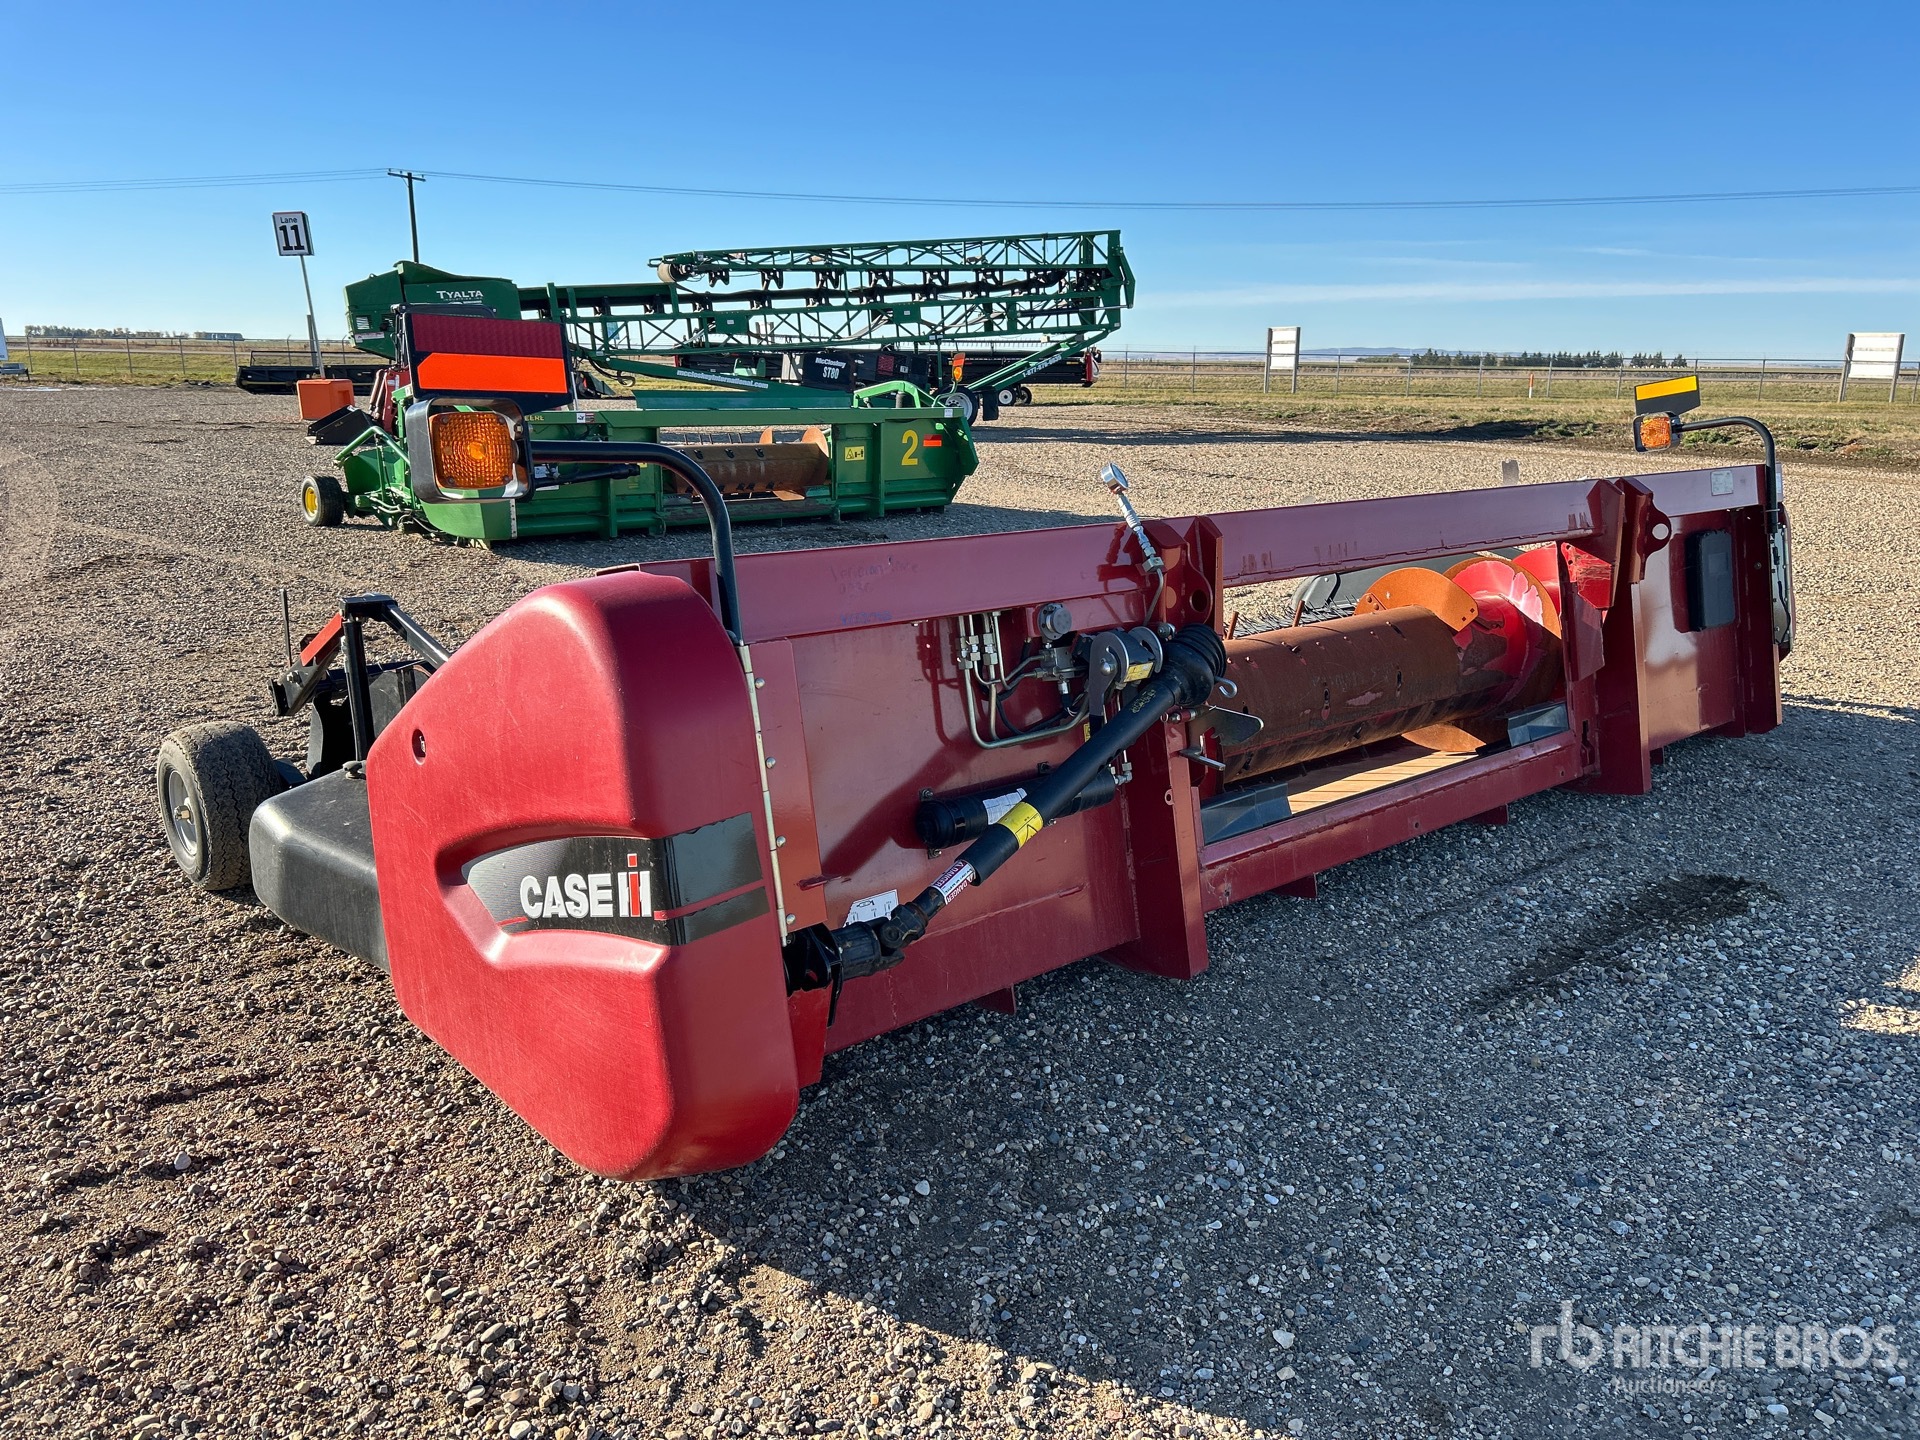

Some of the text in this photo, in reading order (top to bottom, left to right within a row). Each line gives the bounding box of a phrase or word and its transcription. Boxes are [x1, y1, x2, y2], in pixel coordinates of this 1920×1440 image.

[280, 216, 298, 224] Lane
[278, 224, 305, 251] 11
[676, 369, 769, 389] mccloskeyinternational.com
[822, 366, 840, 380] ST80
[901, 429, 919, 466] 2
[934, 866, 959, 888] DANGER
[520, 873, 614, 919] CASE
[946, 879, 968, 903] DANGER
